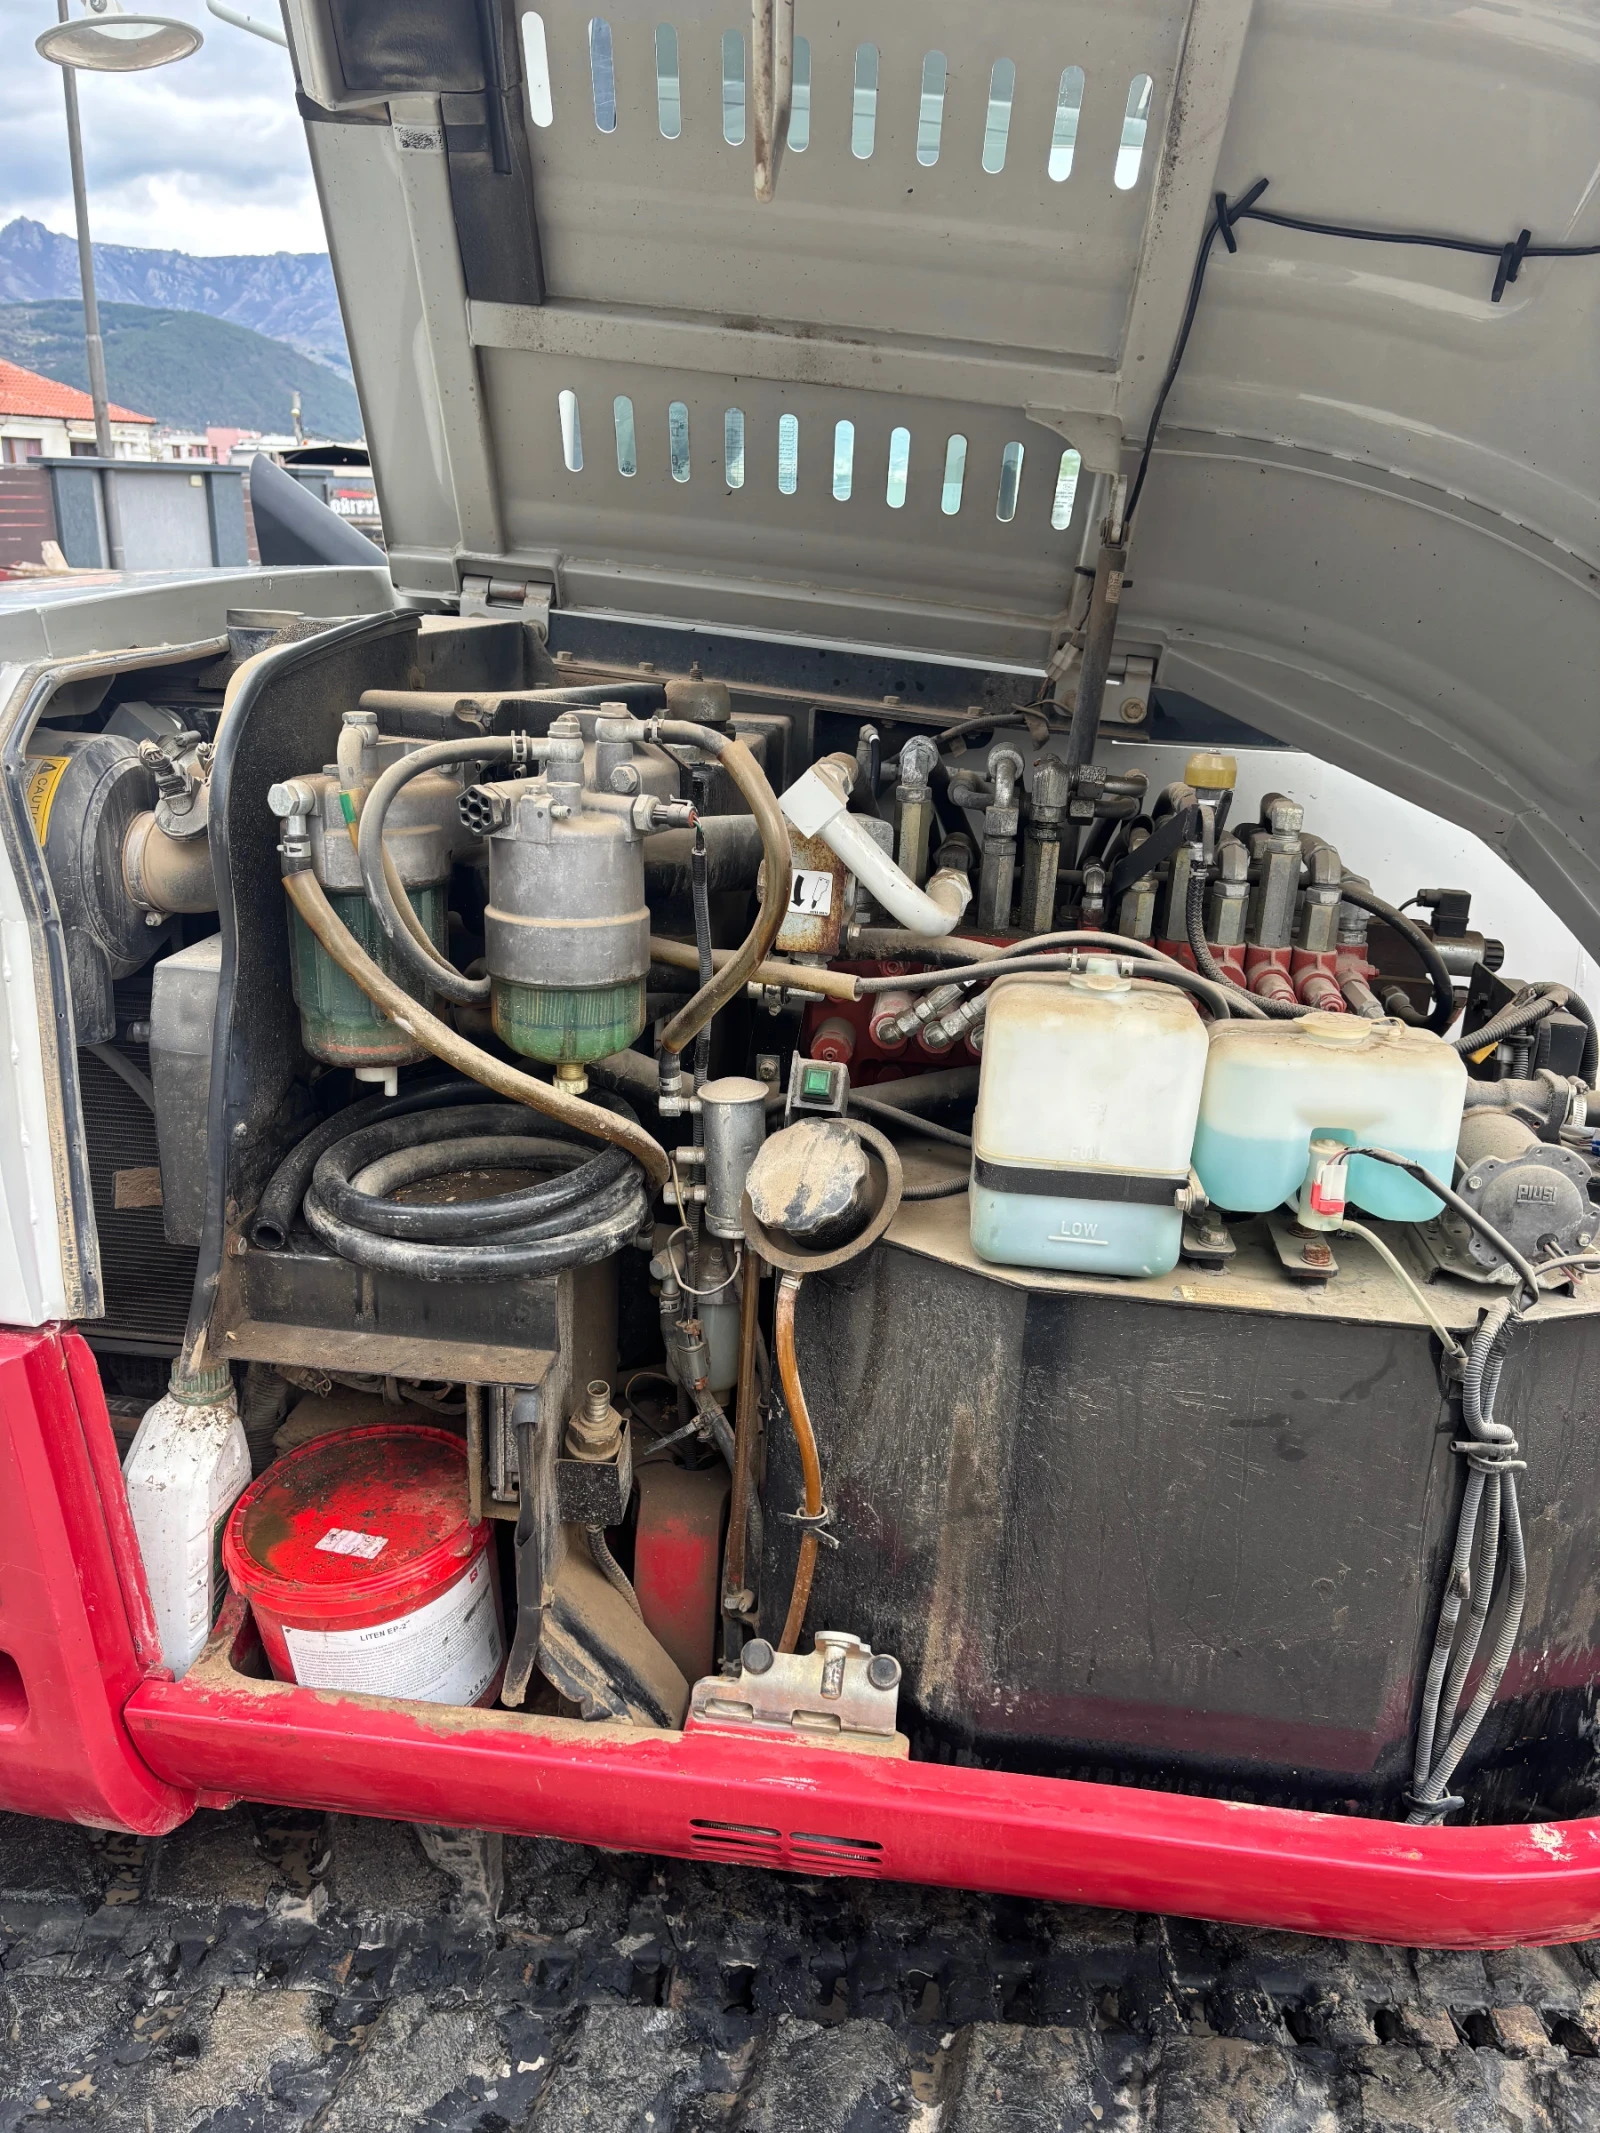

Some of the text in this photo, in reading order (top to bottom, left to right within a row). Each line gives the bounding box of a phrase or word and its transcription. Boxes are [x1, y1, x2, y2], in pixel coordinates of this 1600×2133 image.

[1517, 1184, 1558, 1202] PIUSI
[1060, 1220, 1099, 1237] LOW
[360, 1631, 386, 1642] LITEN
